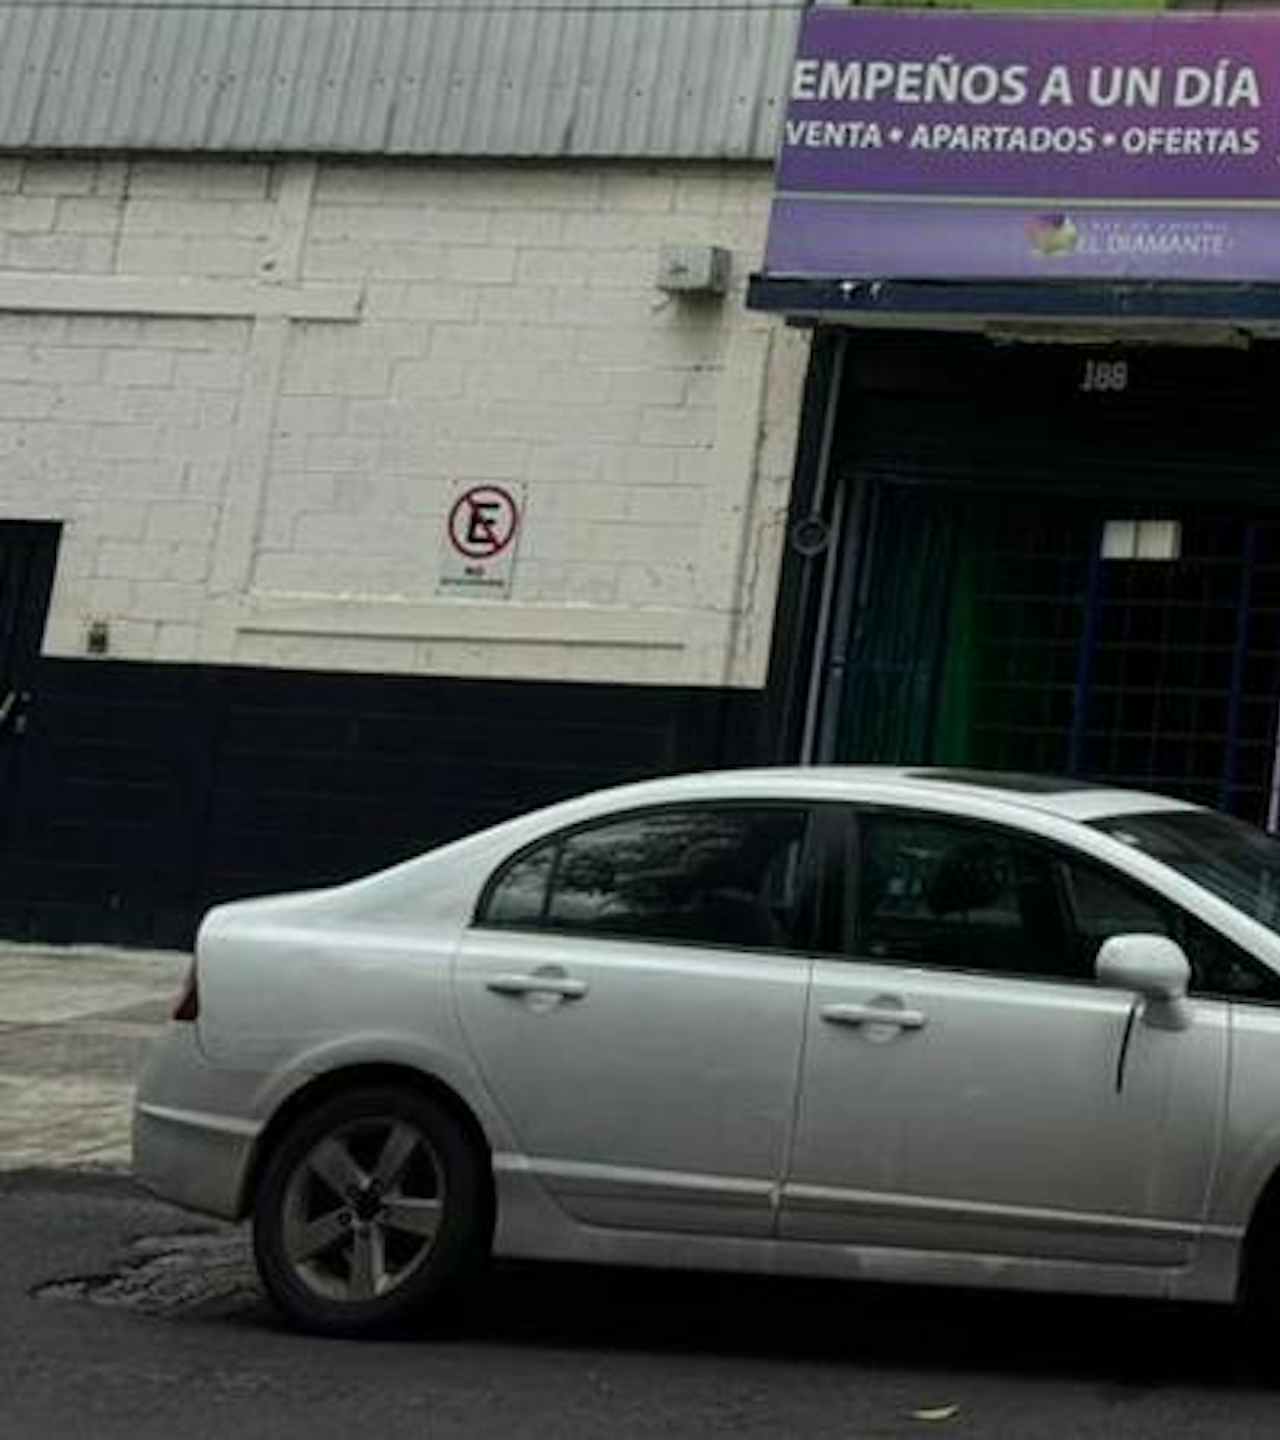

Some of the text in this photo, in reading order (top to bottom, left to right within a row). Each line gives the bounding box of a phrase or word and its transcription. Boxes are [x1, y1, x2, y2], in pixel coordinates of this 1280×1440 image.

[792, 55, 1261, 107] EMPEÑOS A UN DÍA
[786, 121, 1260, 155] VENTA APARTADOS OFERTAS
